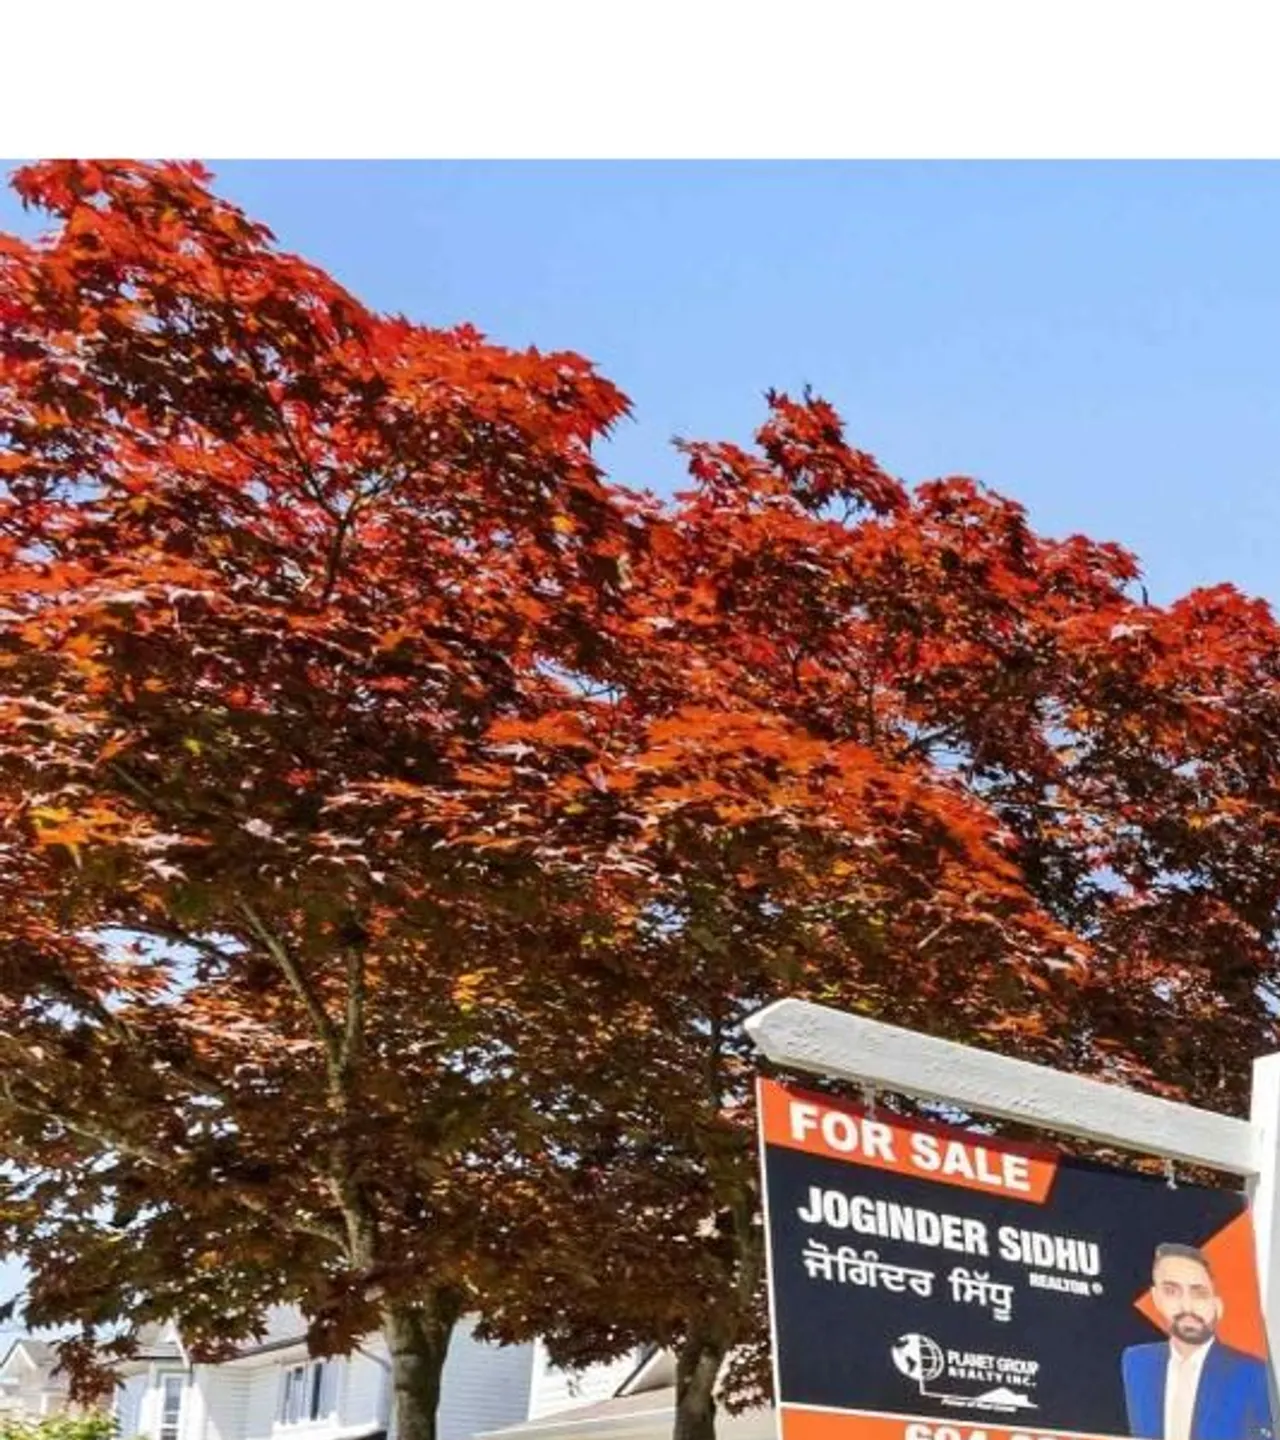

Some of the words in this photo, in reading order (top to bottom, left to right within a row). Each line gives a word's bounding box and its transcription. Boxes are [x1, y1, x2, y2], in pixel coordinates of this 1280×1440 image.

[789, 1100, 896, 1162] FOR
[909, 1131, 1031, 1192] SALE
[797, 1186, 989, 1257] JOGINDER
[998, 1226, 1100, 1276] SIDHU
[801, 1238, 935, 1298] ਜੋਗਿੰਦਰ
[947, 1266, 1015, 1322] ਸਿੱਧੂ
[1029, 1272, 1091, 1296] REALTOR
[947, 1350, 995, 1370] PLANET
[996, 1356, 1040, 1376] GROUP
[947, 1367, 1003, 1383] REALTY
